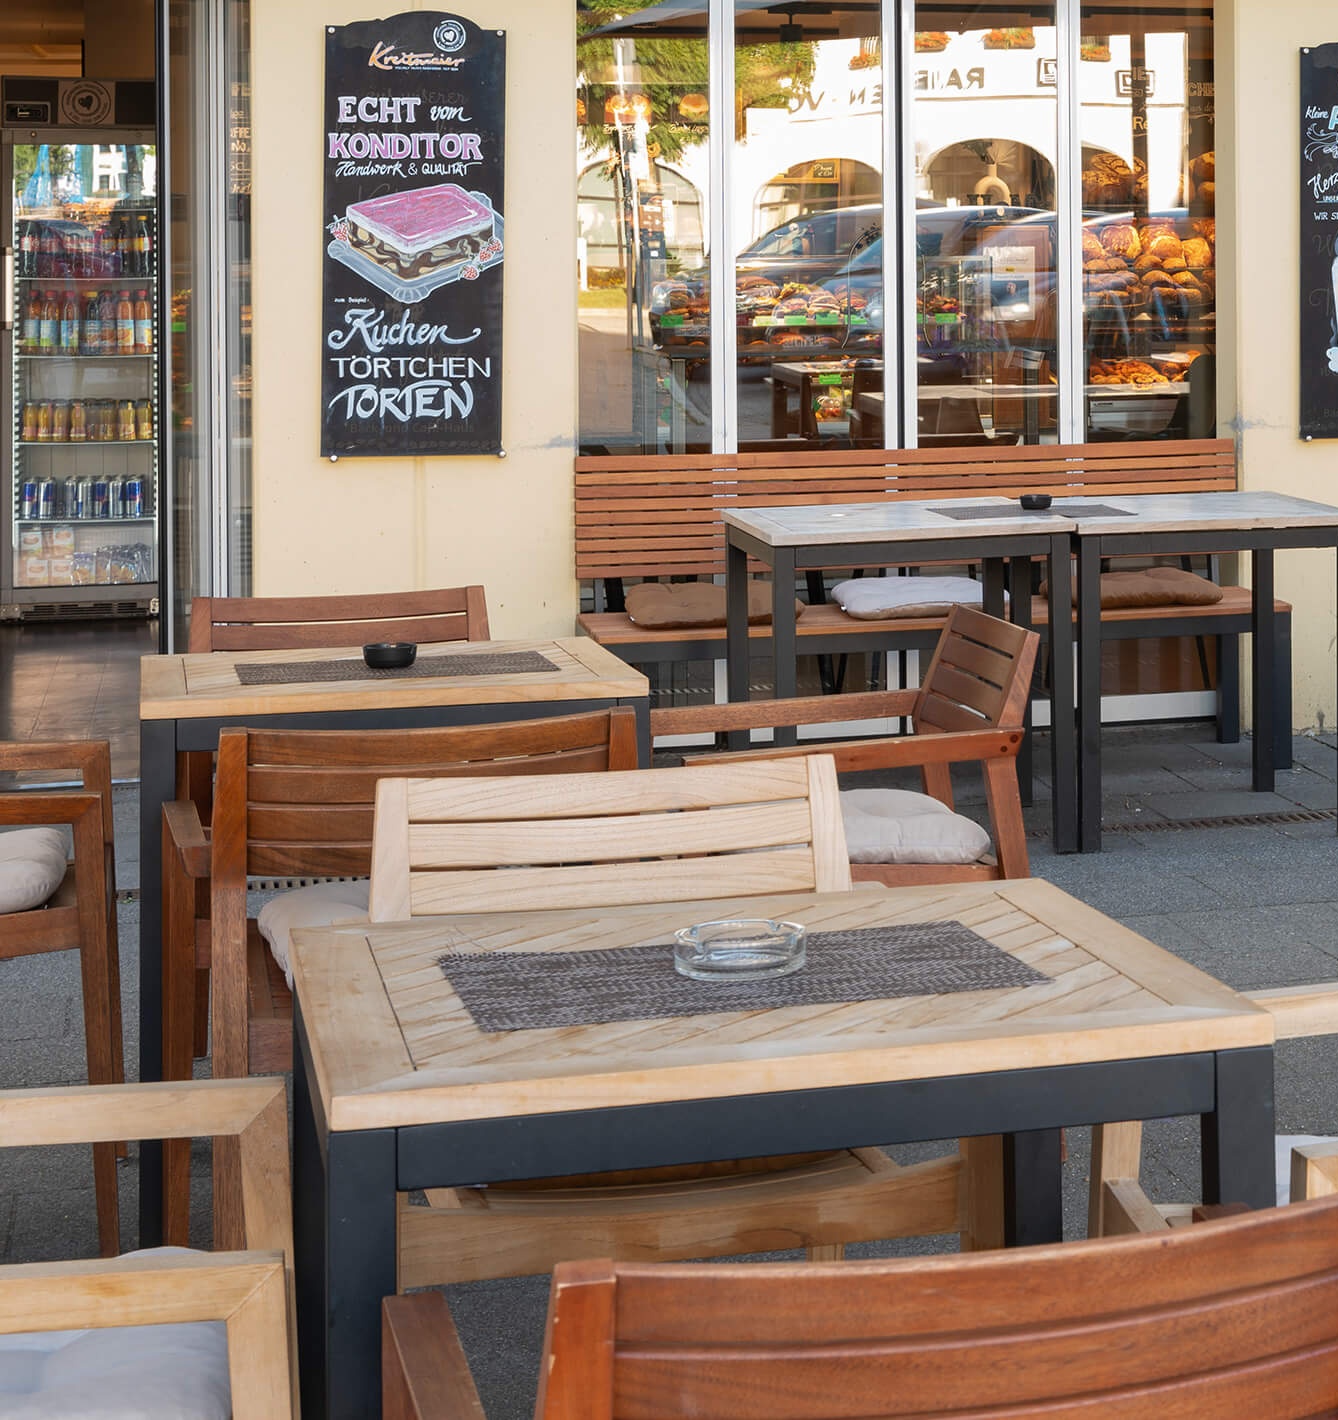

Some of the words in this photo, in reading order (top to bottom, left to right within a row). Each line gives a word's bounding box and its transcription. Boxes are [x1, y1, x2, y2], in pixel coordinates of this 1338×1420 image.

[368, 41, 466, 70] Kreitmaier
[337, 96, 421, 123] ECHT
[430, 105, 472, 122] vom
[328, 132, 484, 160] KONDITOR
[335, 161, 407, 178] Handwerk
[408, 163, 417, 175] &
[421, 161, 482, 176] QUALITÄT
[1313, 212, 1328, 220] WIR
[327, 308, 482, 353] Kuchen
[329, 355, 491, 379] TÖRTCHEN
[327, 379, 474, 422] TORTEN
